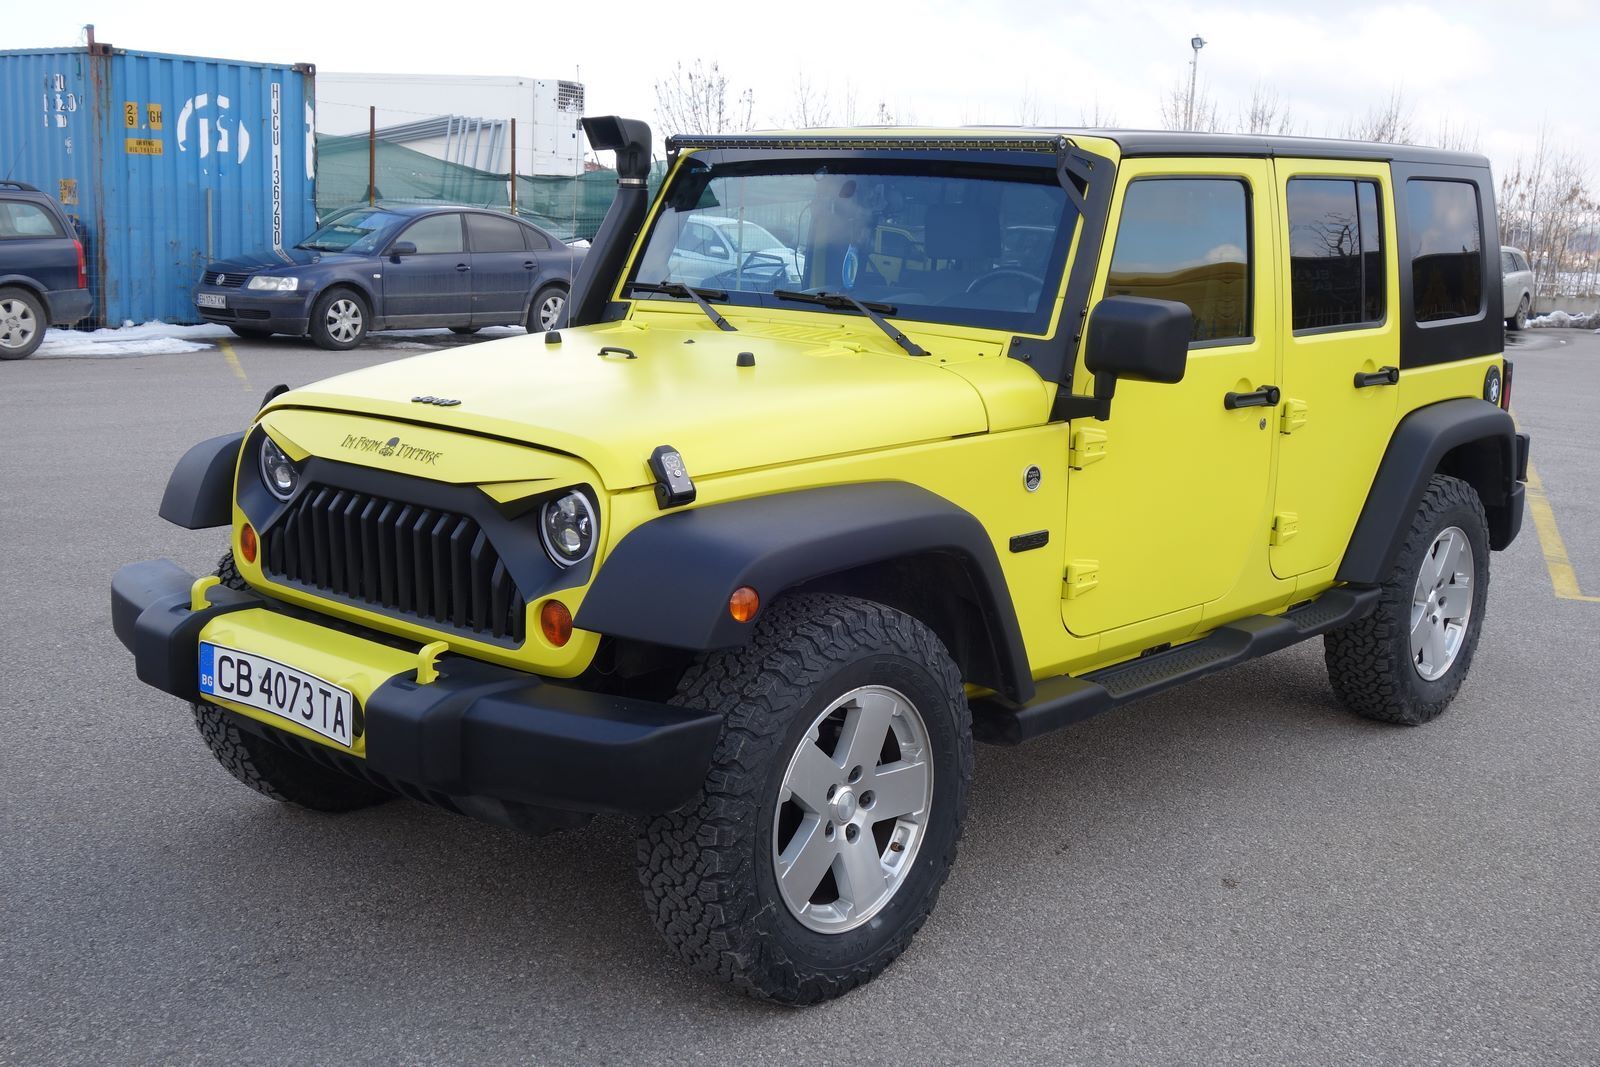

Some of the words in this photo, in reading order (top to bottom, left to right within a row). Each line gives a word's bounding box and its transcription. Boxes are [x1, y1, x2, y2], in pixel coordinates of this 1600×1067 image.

[127, 104, 134, 115] 2
[128, 115, 134, 126] 9
[272, 84, 280, 146] HJCU
[272, 155, 281, 246] 136290
[201, 673, 213, 687] BG
[218, 655, 253, 698] CB
[259, 667, 314, 721] 4073
[319, 687, 346, 738] TA
